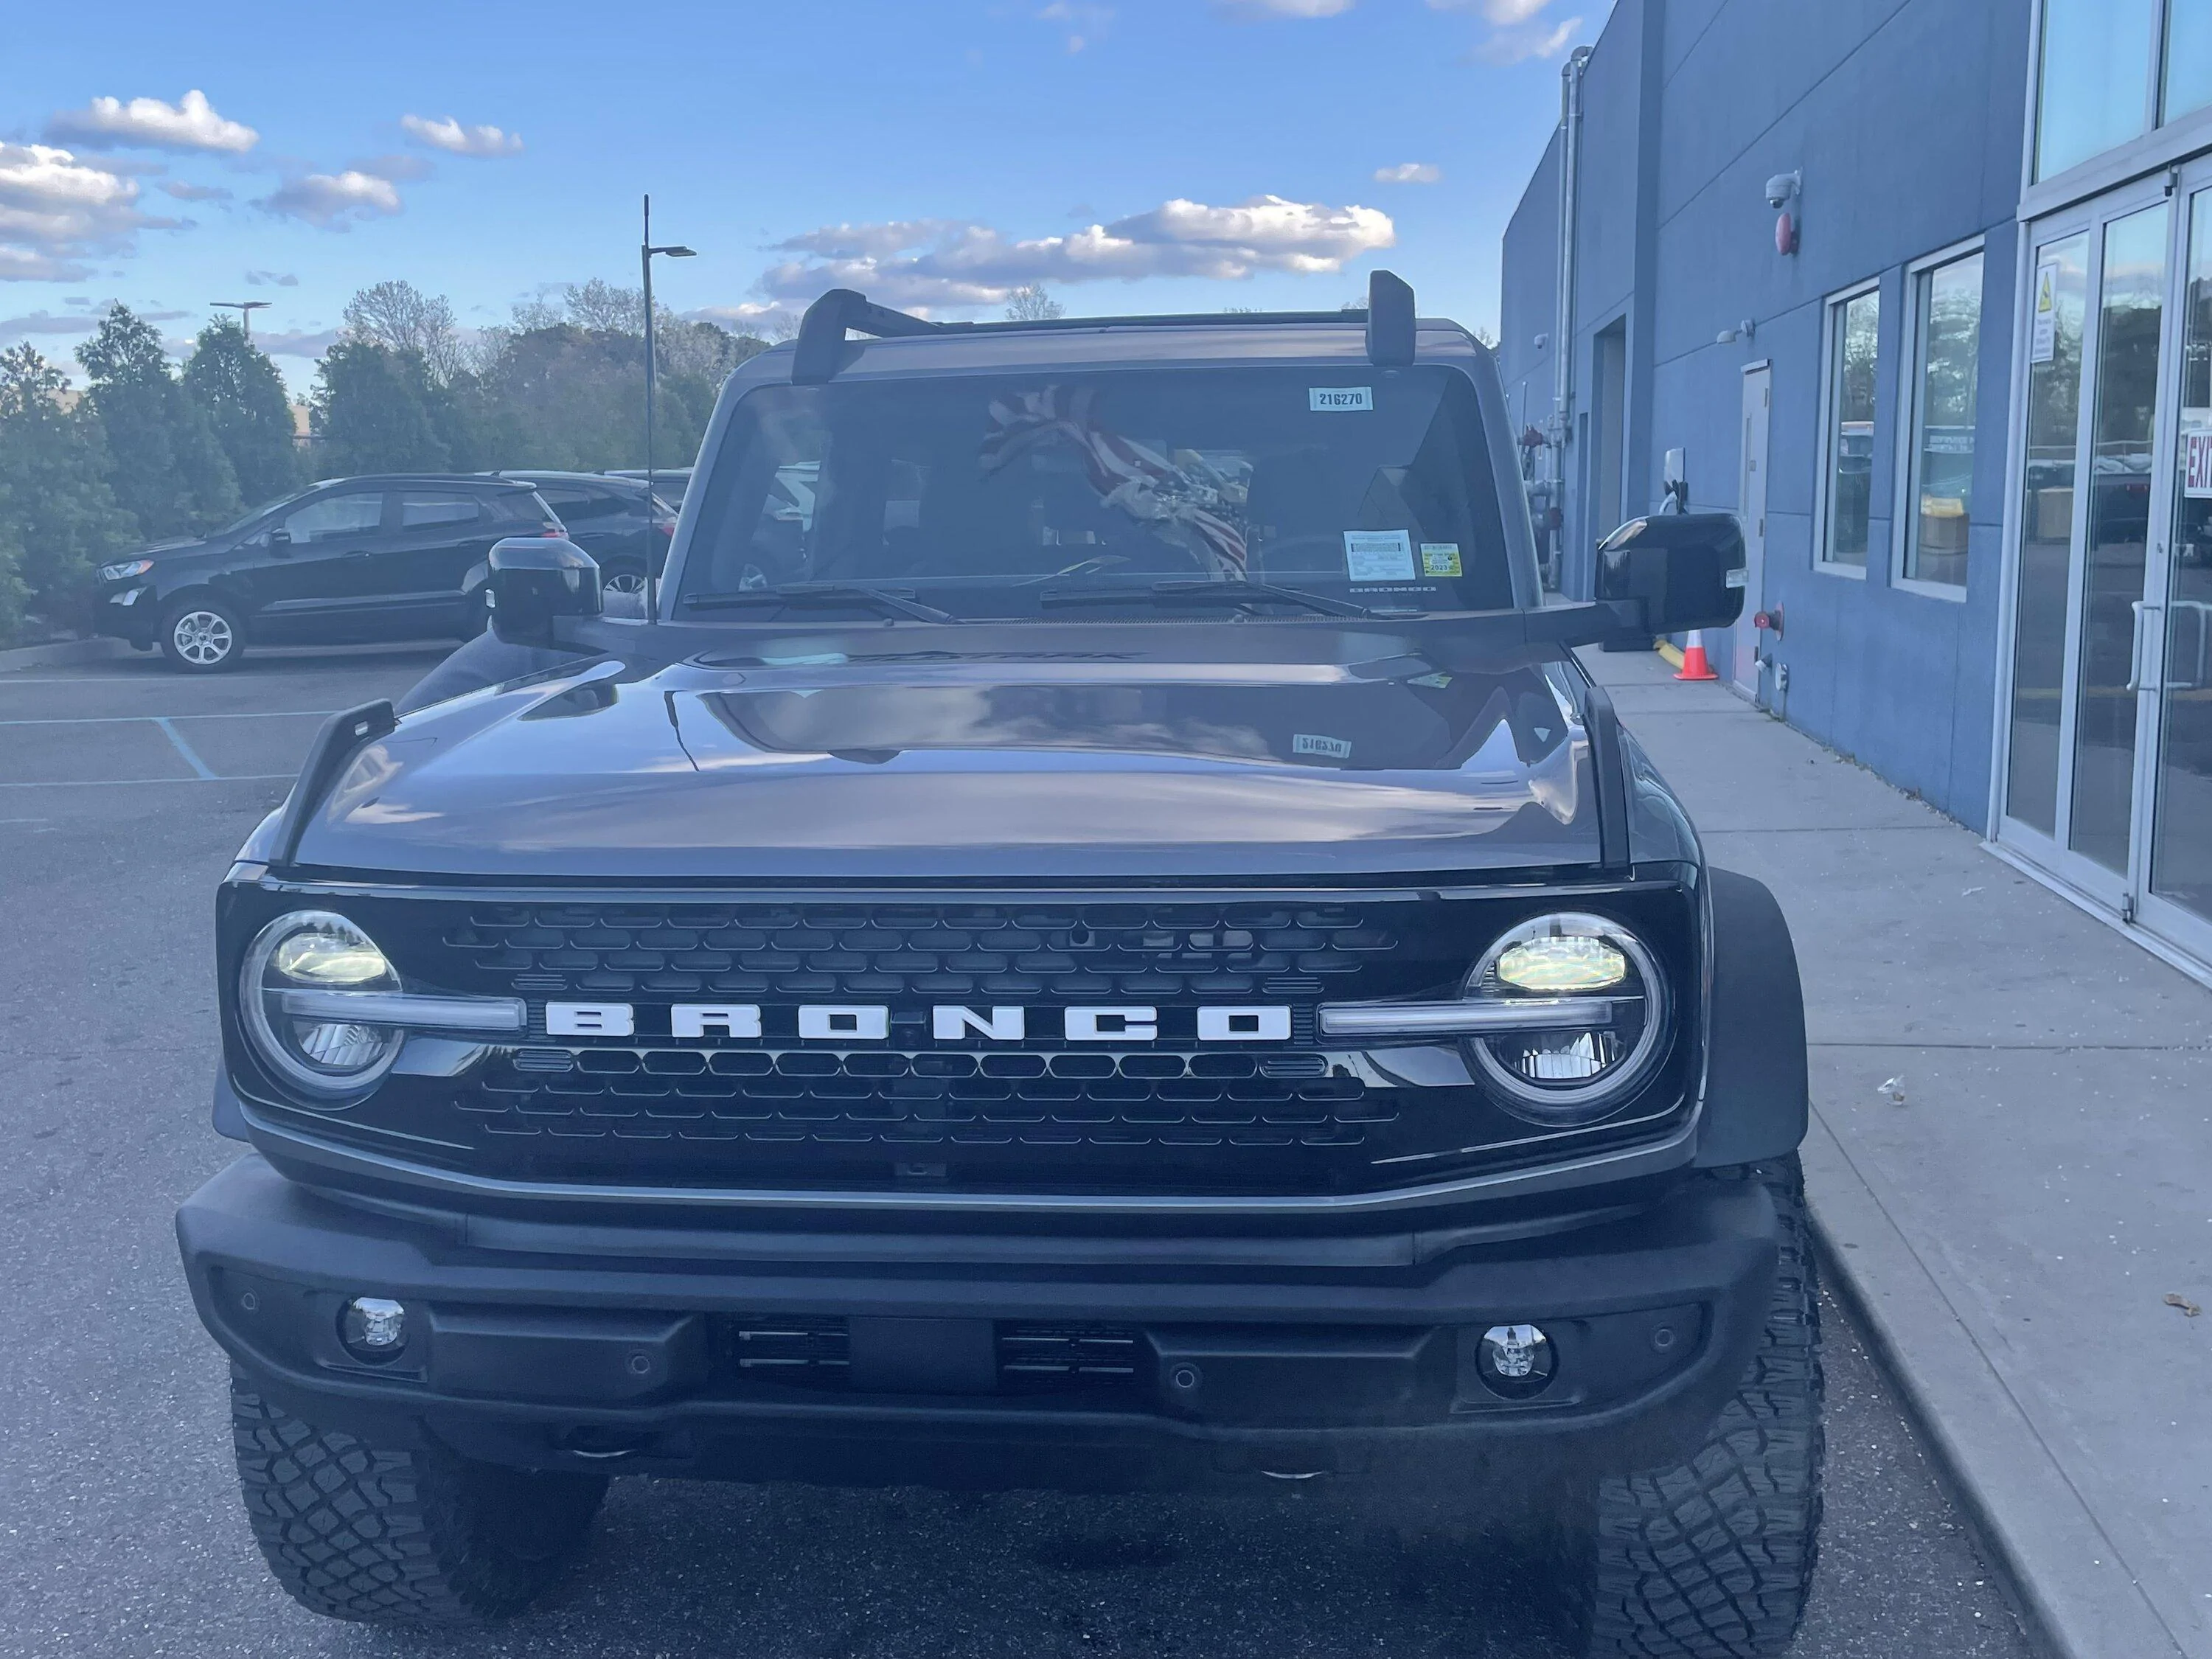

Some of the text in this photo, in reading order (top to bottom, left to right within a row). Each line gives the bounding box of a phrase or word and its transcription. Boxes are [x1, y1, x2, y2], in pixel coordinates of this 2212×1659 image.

[1319, 393, 1363, 406] 216270
[2188, 436, 2212, 487] EXI
[546, 1001, 1291, 1041] BRONCO
